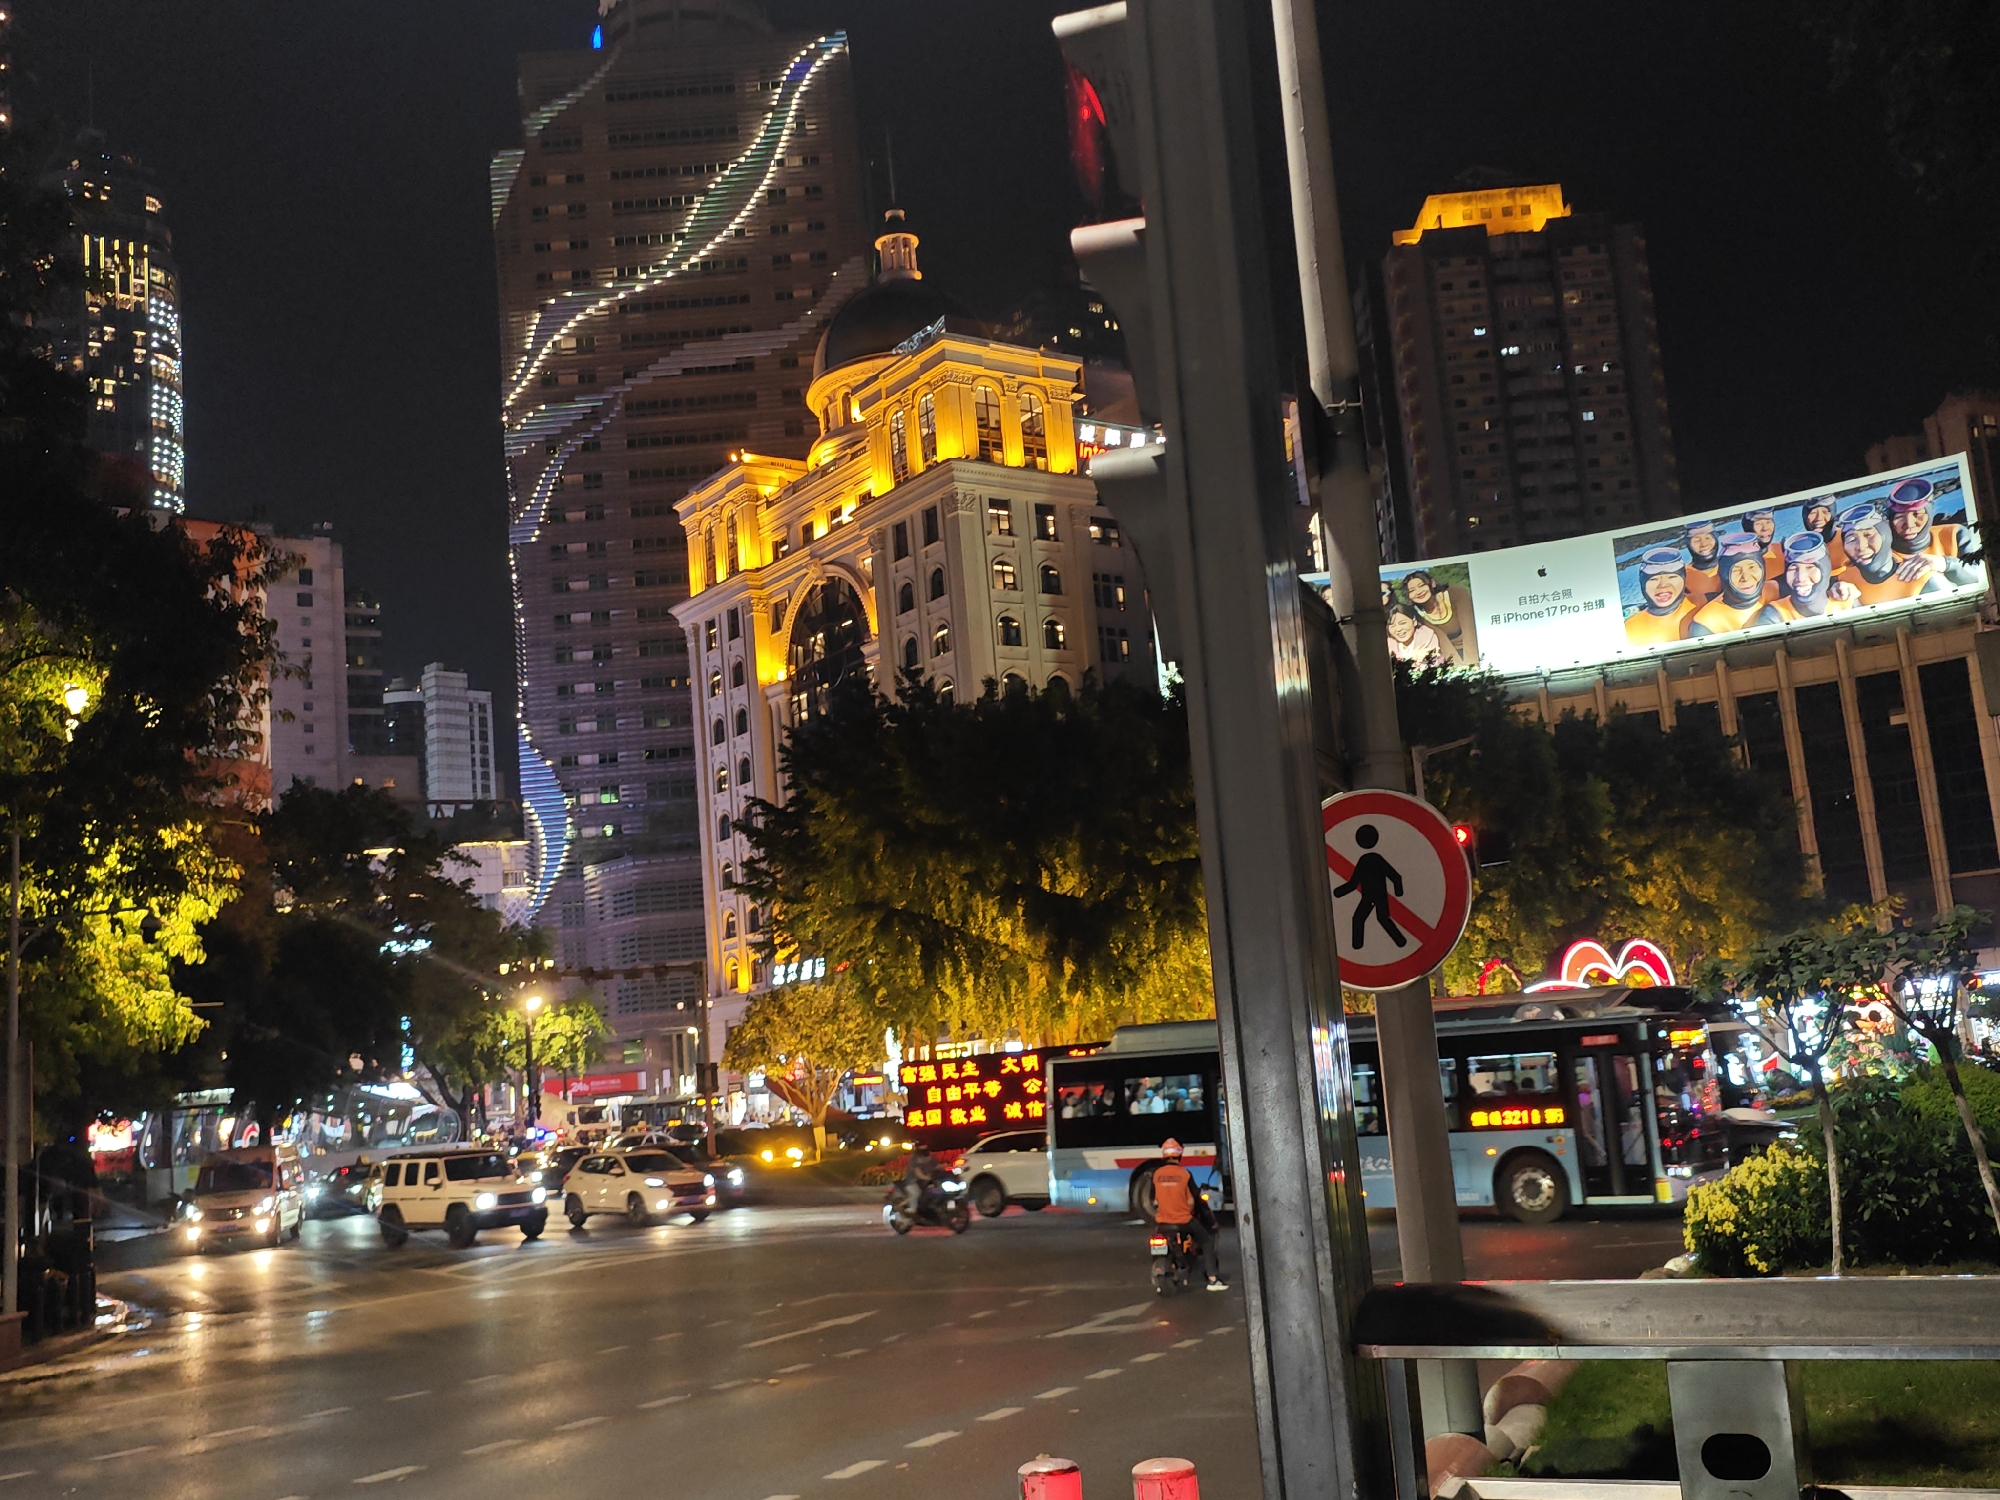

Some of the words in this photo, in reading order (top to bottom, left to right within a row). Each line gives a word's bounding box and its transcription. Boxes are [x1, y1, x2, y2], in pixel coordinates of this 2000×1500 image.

[1518, 589, 1573, 606] 自拍大合照
[1490, 614, 1501, 625] 用
[1503, 610, 1545, 623] iPhone
[1546, 606, 1557, 617] 17
[1560, 604, 1580, 615] Pro
[1583, 599, 1605, 611] 拍摄
[1000, 1055, 1039, 1074] 文明
[1003, 1100, 1046, 1119] 诚信
